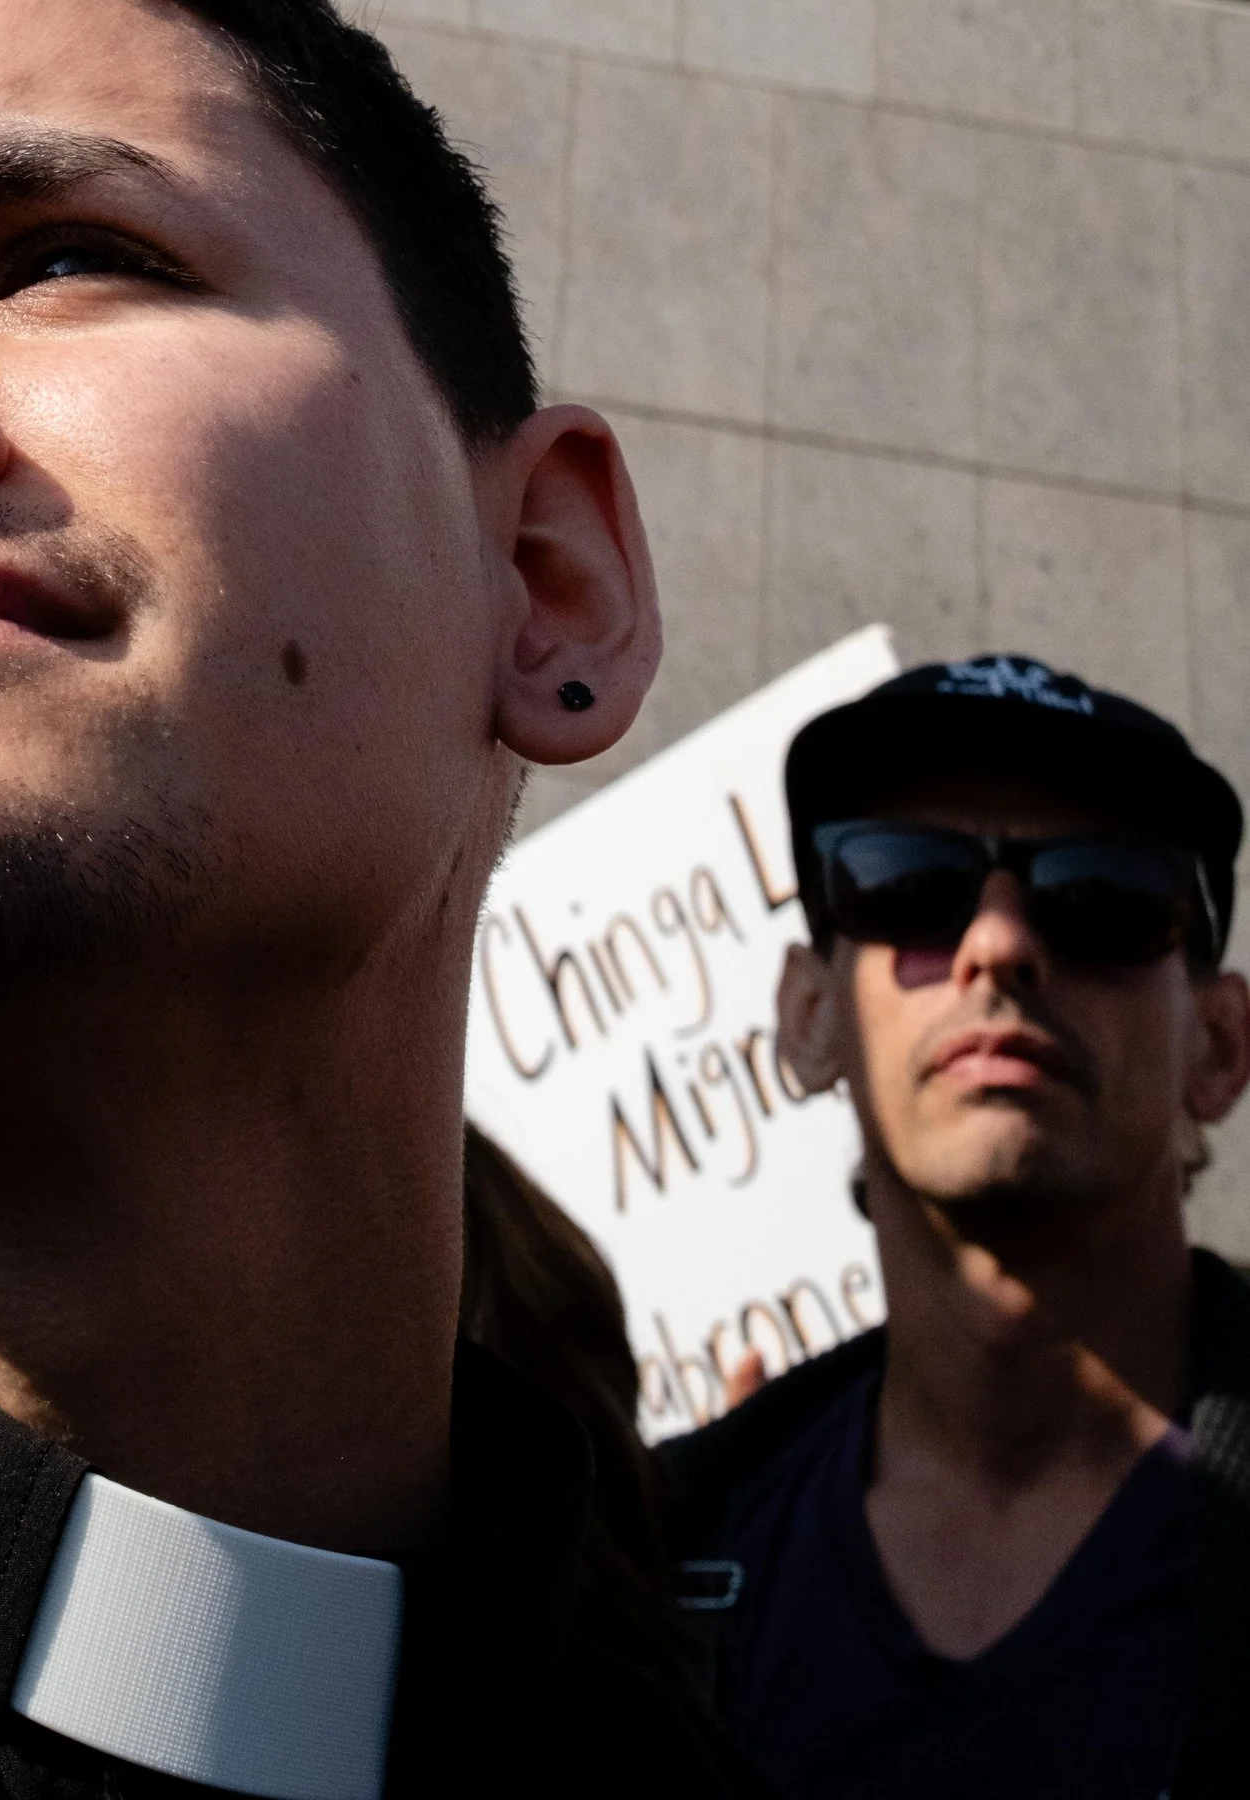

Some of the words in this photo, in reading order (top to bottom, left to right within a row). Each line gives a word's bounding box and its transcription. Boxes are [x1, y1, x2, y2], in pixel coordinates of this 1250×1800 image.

[481, 864, 747, 1080] Chinga
[728, 789, 800, 912] L
[638, 1260, 872, 1426] abrone
